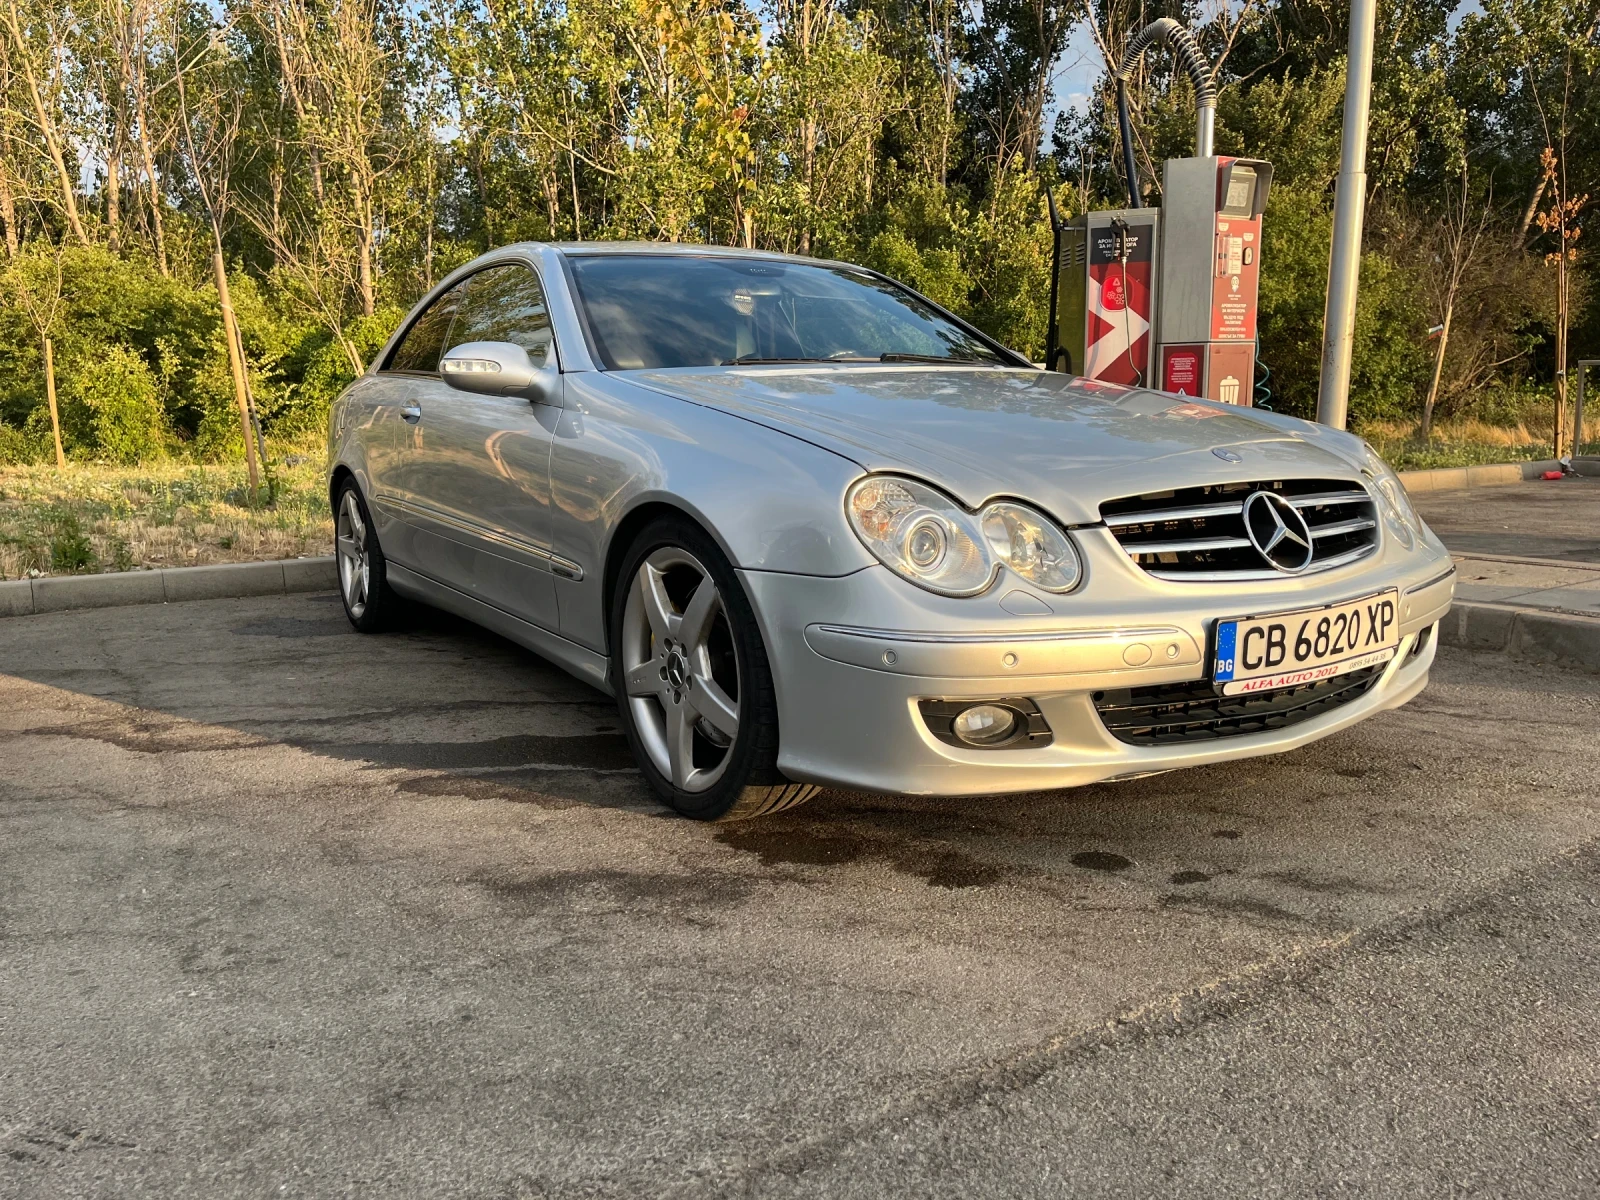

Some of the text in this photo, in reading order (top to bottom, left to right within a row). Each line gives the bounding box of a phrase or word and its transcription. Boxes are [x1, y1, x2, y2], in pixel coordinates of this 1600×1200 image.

[1243, 600, 1394, 670] CB 6820 XP
[1217, 658, 1233, 673] BG
[1240, 666, 1339, 692] ALFA AUTO 2012
